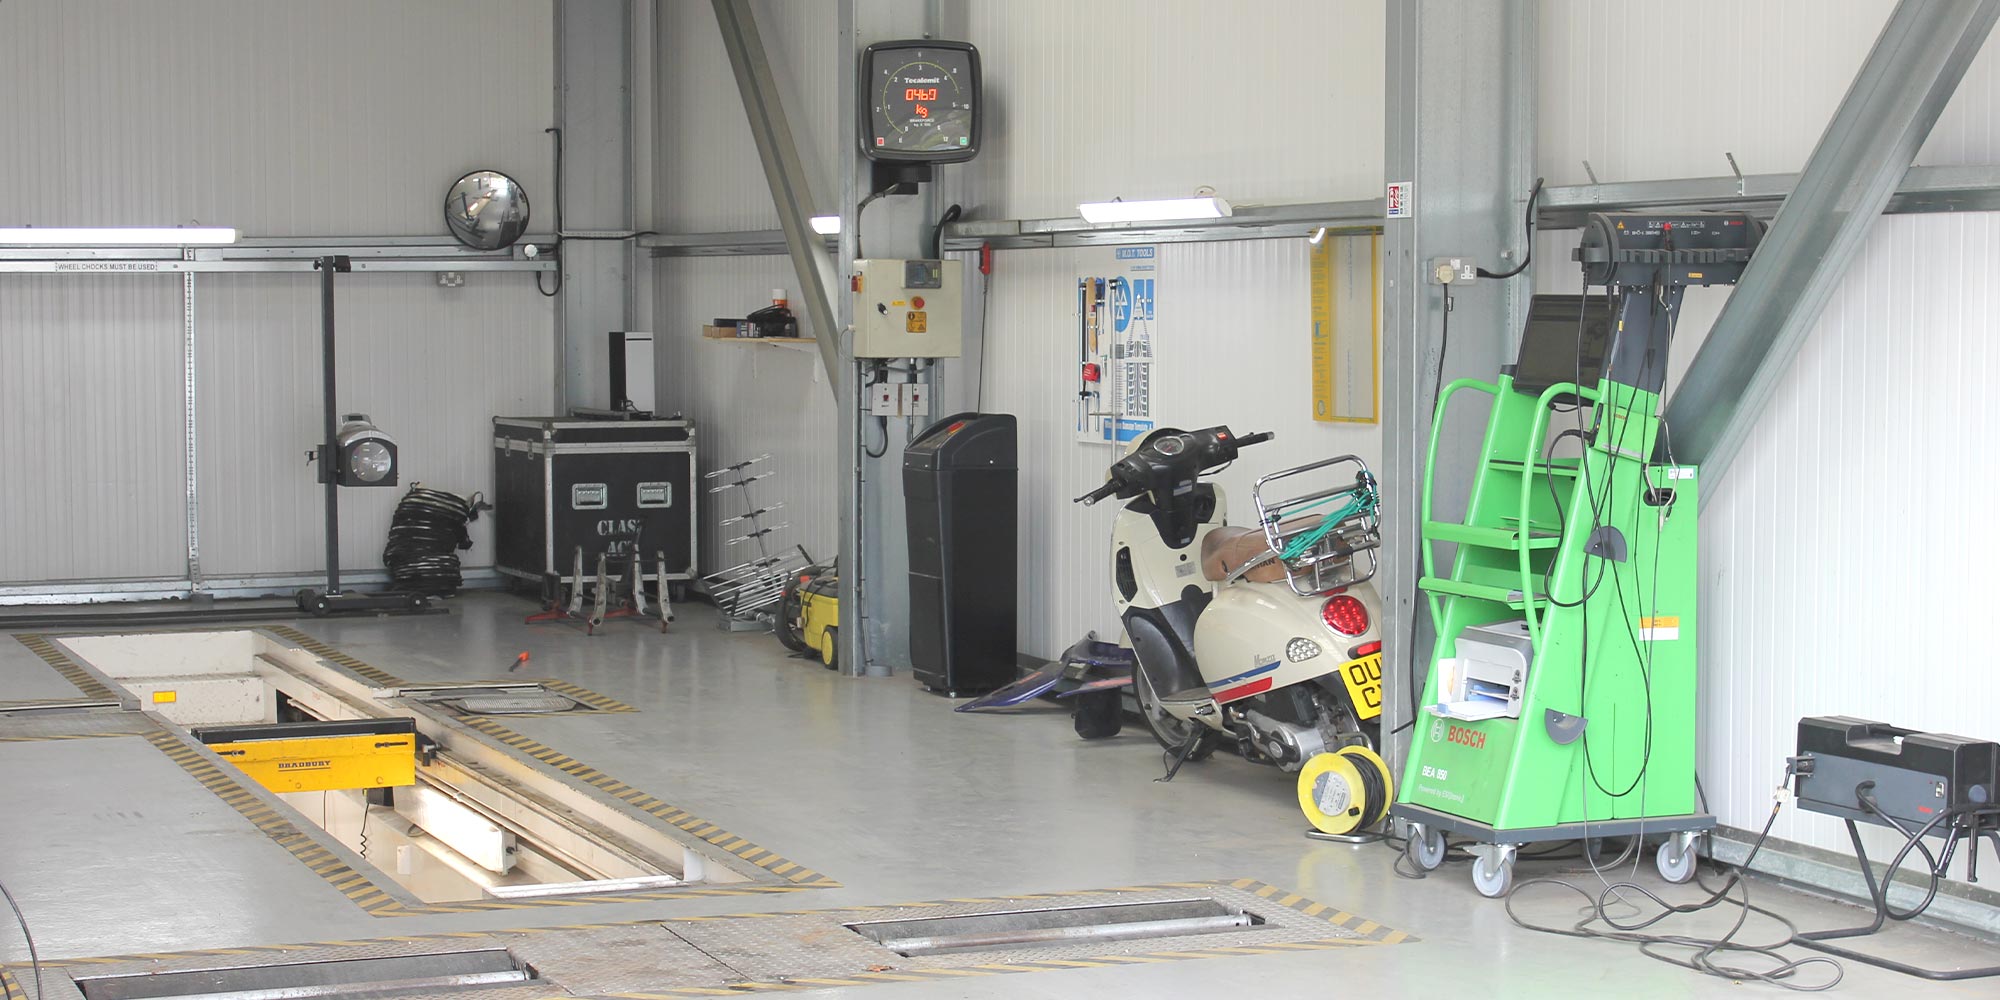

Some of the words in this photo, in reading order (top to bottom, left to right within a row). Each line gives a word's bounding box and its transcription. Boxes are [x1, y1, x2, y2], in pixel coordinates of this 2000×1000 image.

[915, 104, 928, 118] kg
[1137, 248, 1152, 257] TOOLS
[1349, 656, 1381, 686] OU
[1362, 684, 1381, 708] C
[1448, 725, 1486, 750] BOSCH
[278, 760, 330, 768] BRADBURY
[1422, 766, 1436, 778] BEA
